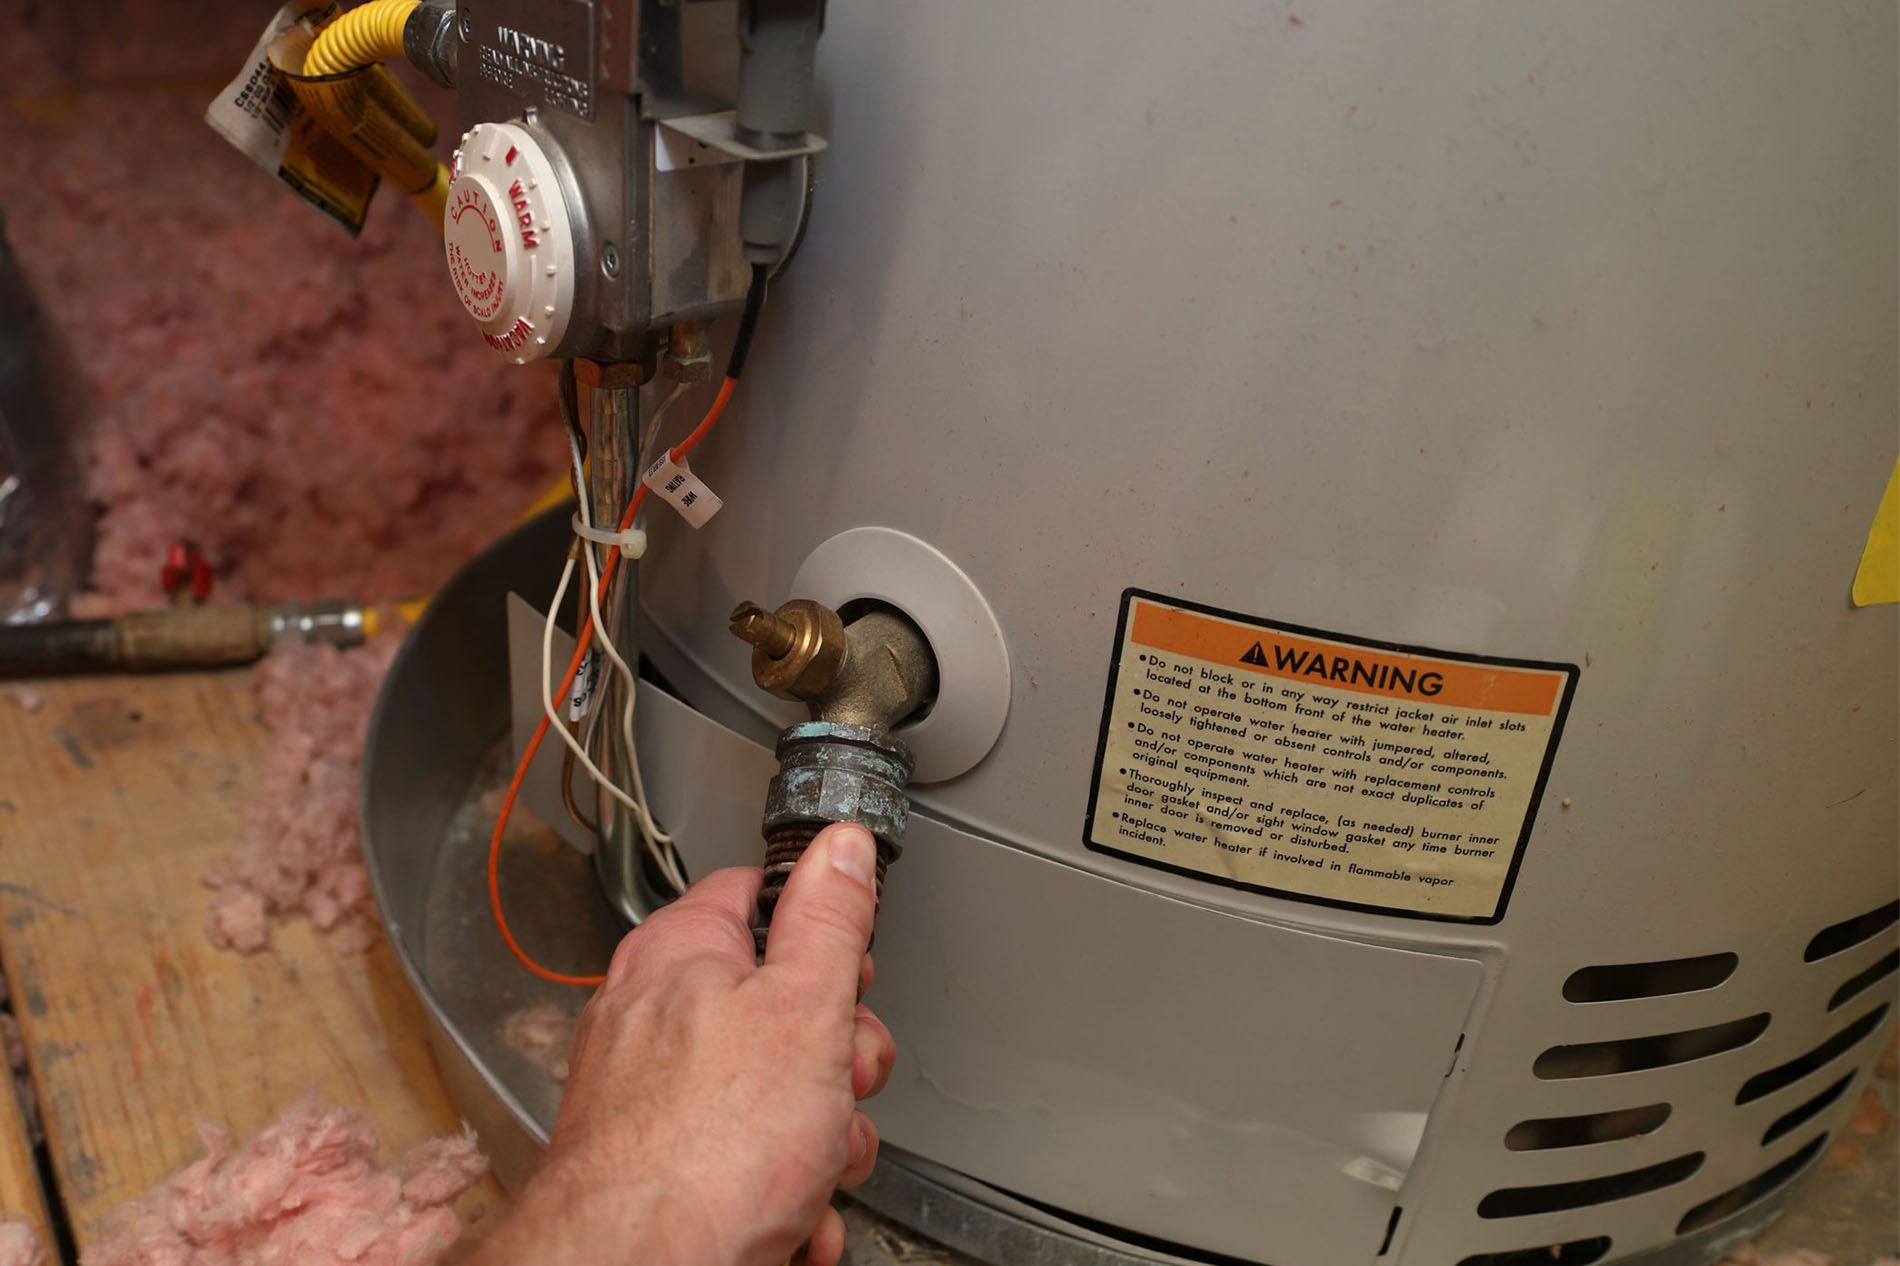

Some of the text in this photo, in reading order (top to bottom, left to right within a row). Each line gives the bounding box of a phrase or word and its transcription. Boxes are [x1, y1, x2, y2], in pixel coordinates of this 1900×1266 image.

[450, 188, 502, 252] CAUTION
[508, 179, 538, 249] WARM
[455, 245, 470, 287] WATER
[1146, 668, 1464, 740] located at the bottom front of the water heater.
[1149, 655, 1525, 731] Do not block or in any way restrict jacket air inlet slots
[1274, 645, 1444, 697] WARNING
[1137, 722, 1495, 798] Do not operate water heater with replacement controls
[1140, 702, 1506, 779] loosely tightened or absent controls and/or components.
[1143, 689, 1490, 765] Do not operate water heater with jumpered, altered,
[1132, 752, 1249, 787] original equipment.
[1134, 739, 1485, 810] and/or components which are not exact duplicates of
[1119, 825, 1165, 846] incident.
[1124, 794, 1154, 810] inner
[1160, 805, 1189, 820] door
[1195, 813, 1205, 824] is
[1211, 820, 1264, 837] removed
[1290, 834, 1349, 853] disturbed.
[1126, 782, 1495, 857] door gasket and/or sight window gasket any time burner
[1129, 768, 1500, 844] Thoroughly inspect and replace, (as needed) burner inner
[1121, 812, 1454, 887] Replace water heater if involved in flammable vapor
